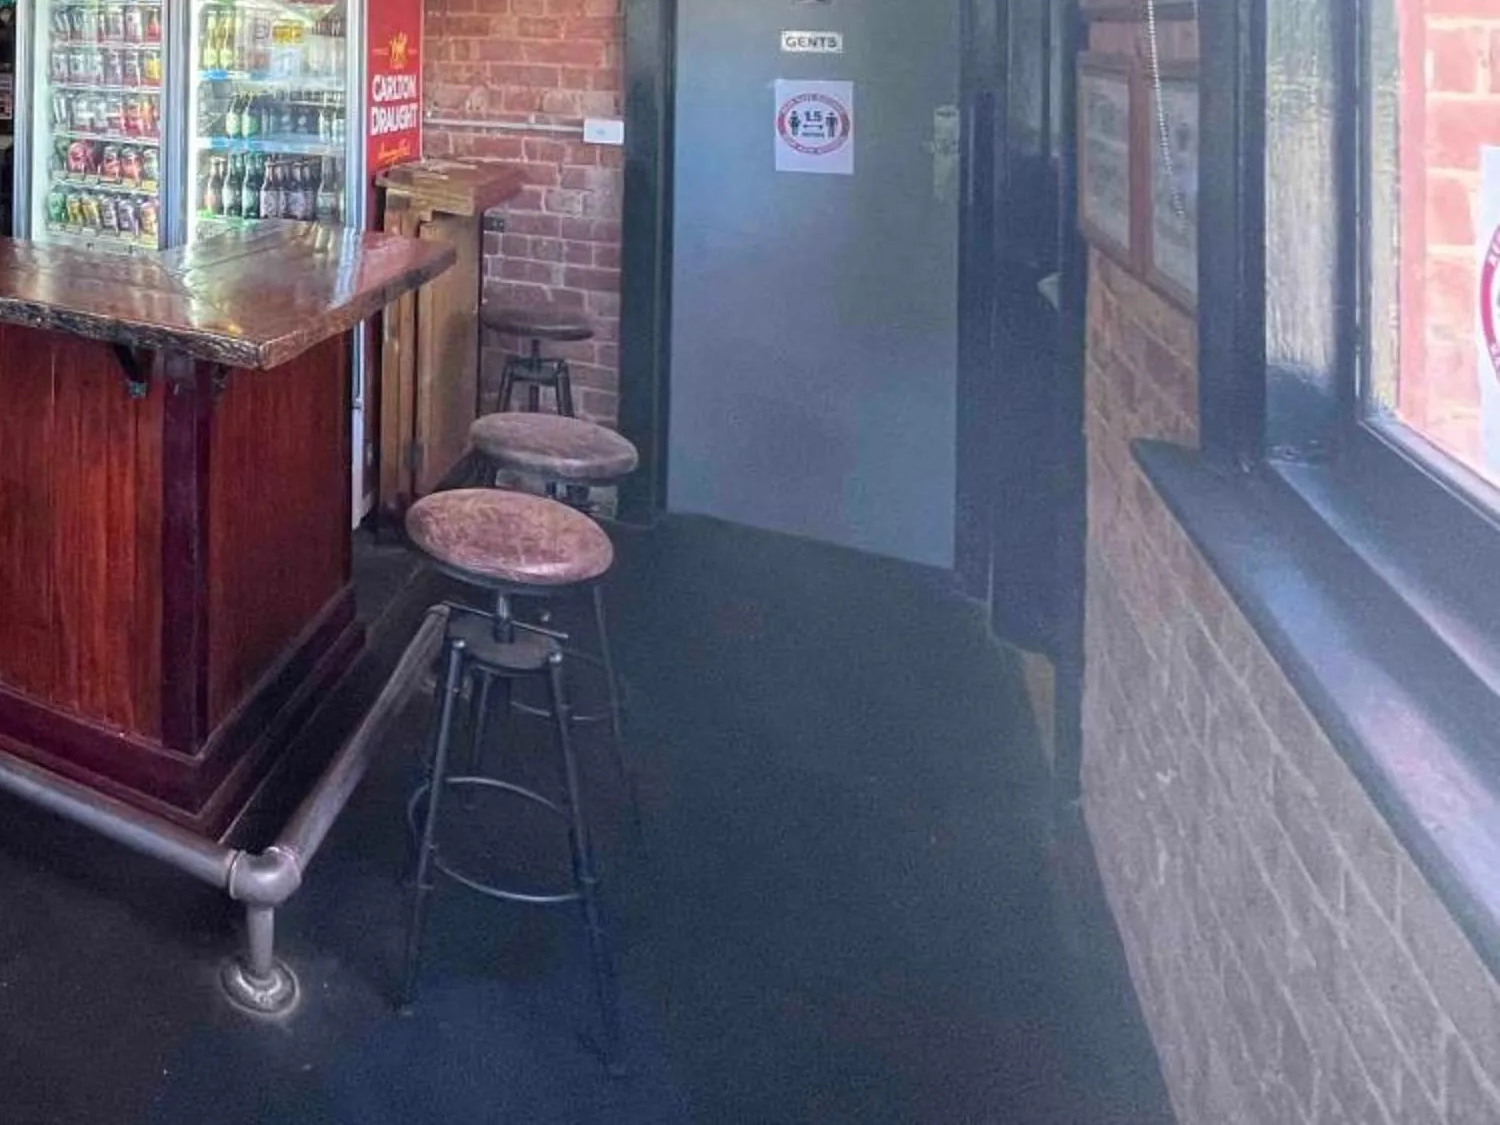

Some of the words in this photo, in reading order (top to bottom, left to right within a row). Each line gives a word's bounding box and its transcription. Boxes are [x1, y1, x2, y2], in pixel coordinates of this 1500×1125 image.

[785, 36, 838, 49] GENTS
[372, 74, 417, 103] CARLTON
[370, 103, 418, 136] DRAUGHT
